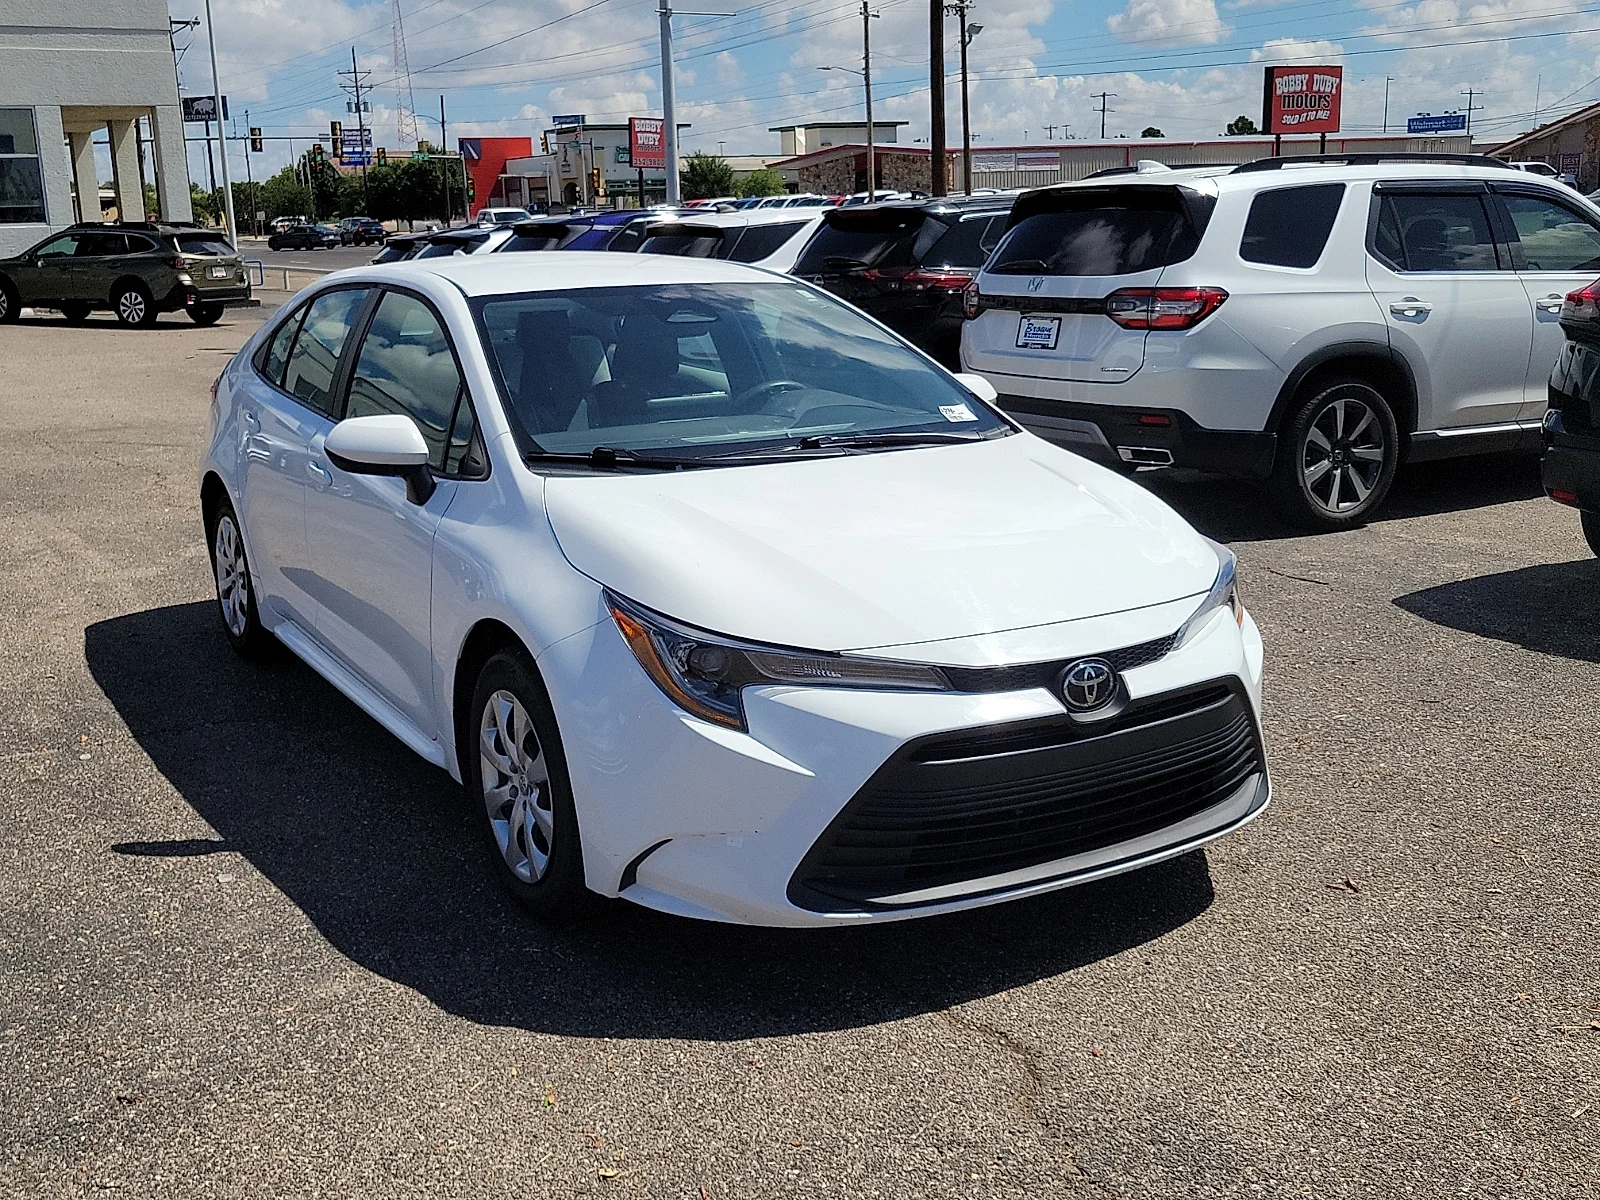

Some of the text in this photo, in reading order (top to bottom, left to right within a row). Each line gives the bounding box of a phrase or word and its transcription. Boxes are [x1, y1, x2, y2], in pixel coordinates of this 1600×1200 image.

[1275, 74, 1340, 95] BOBBY DUBY
[1281, 92, 1331, 110] motors
[1281, 114, 1299, 125] SOLD
[1299, 112, 1307, 123] IT
[1307, 111, 1316, 121] TO
[1410, 119, 1446, 129] Walmart
[634, 120, 663, 133] BOBBY
[637, 133, 661, 146] DUBY
[1025, 322, 1053, 333] Brown
